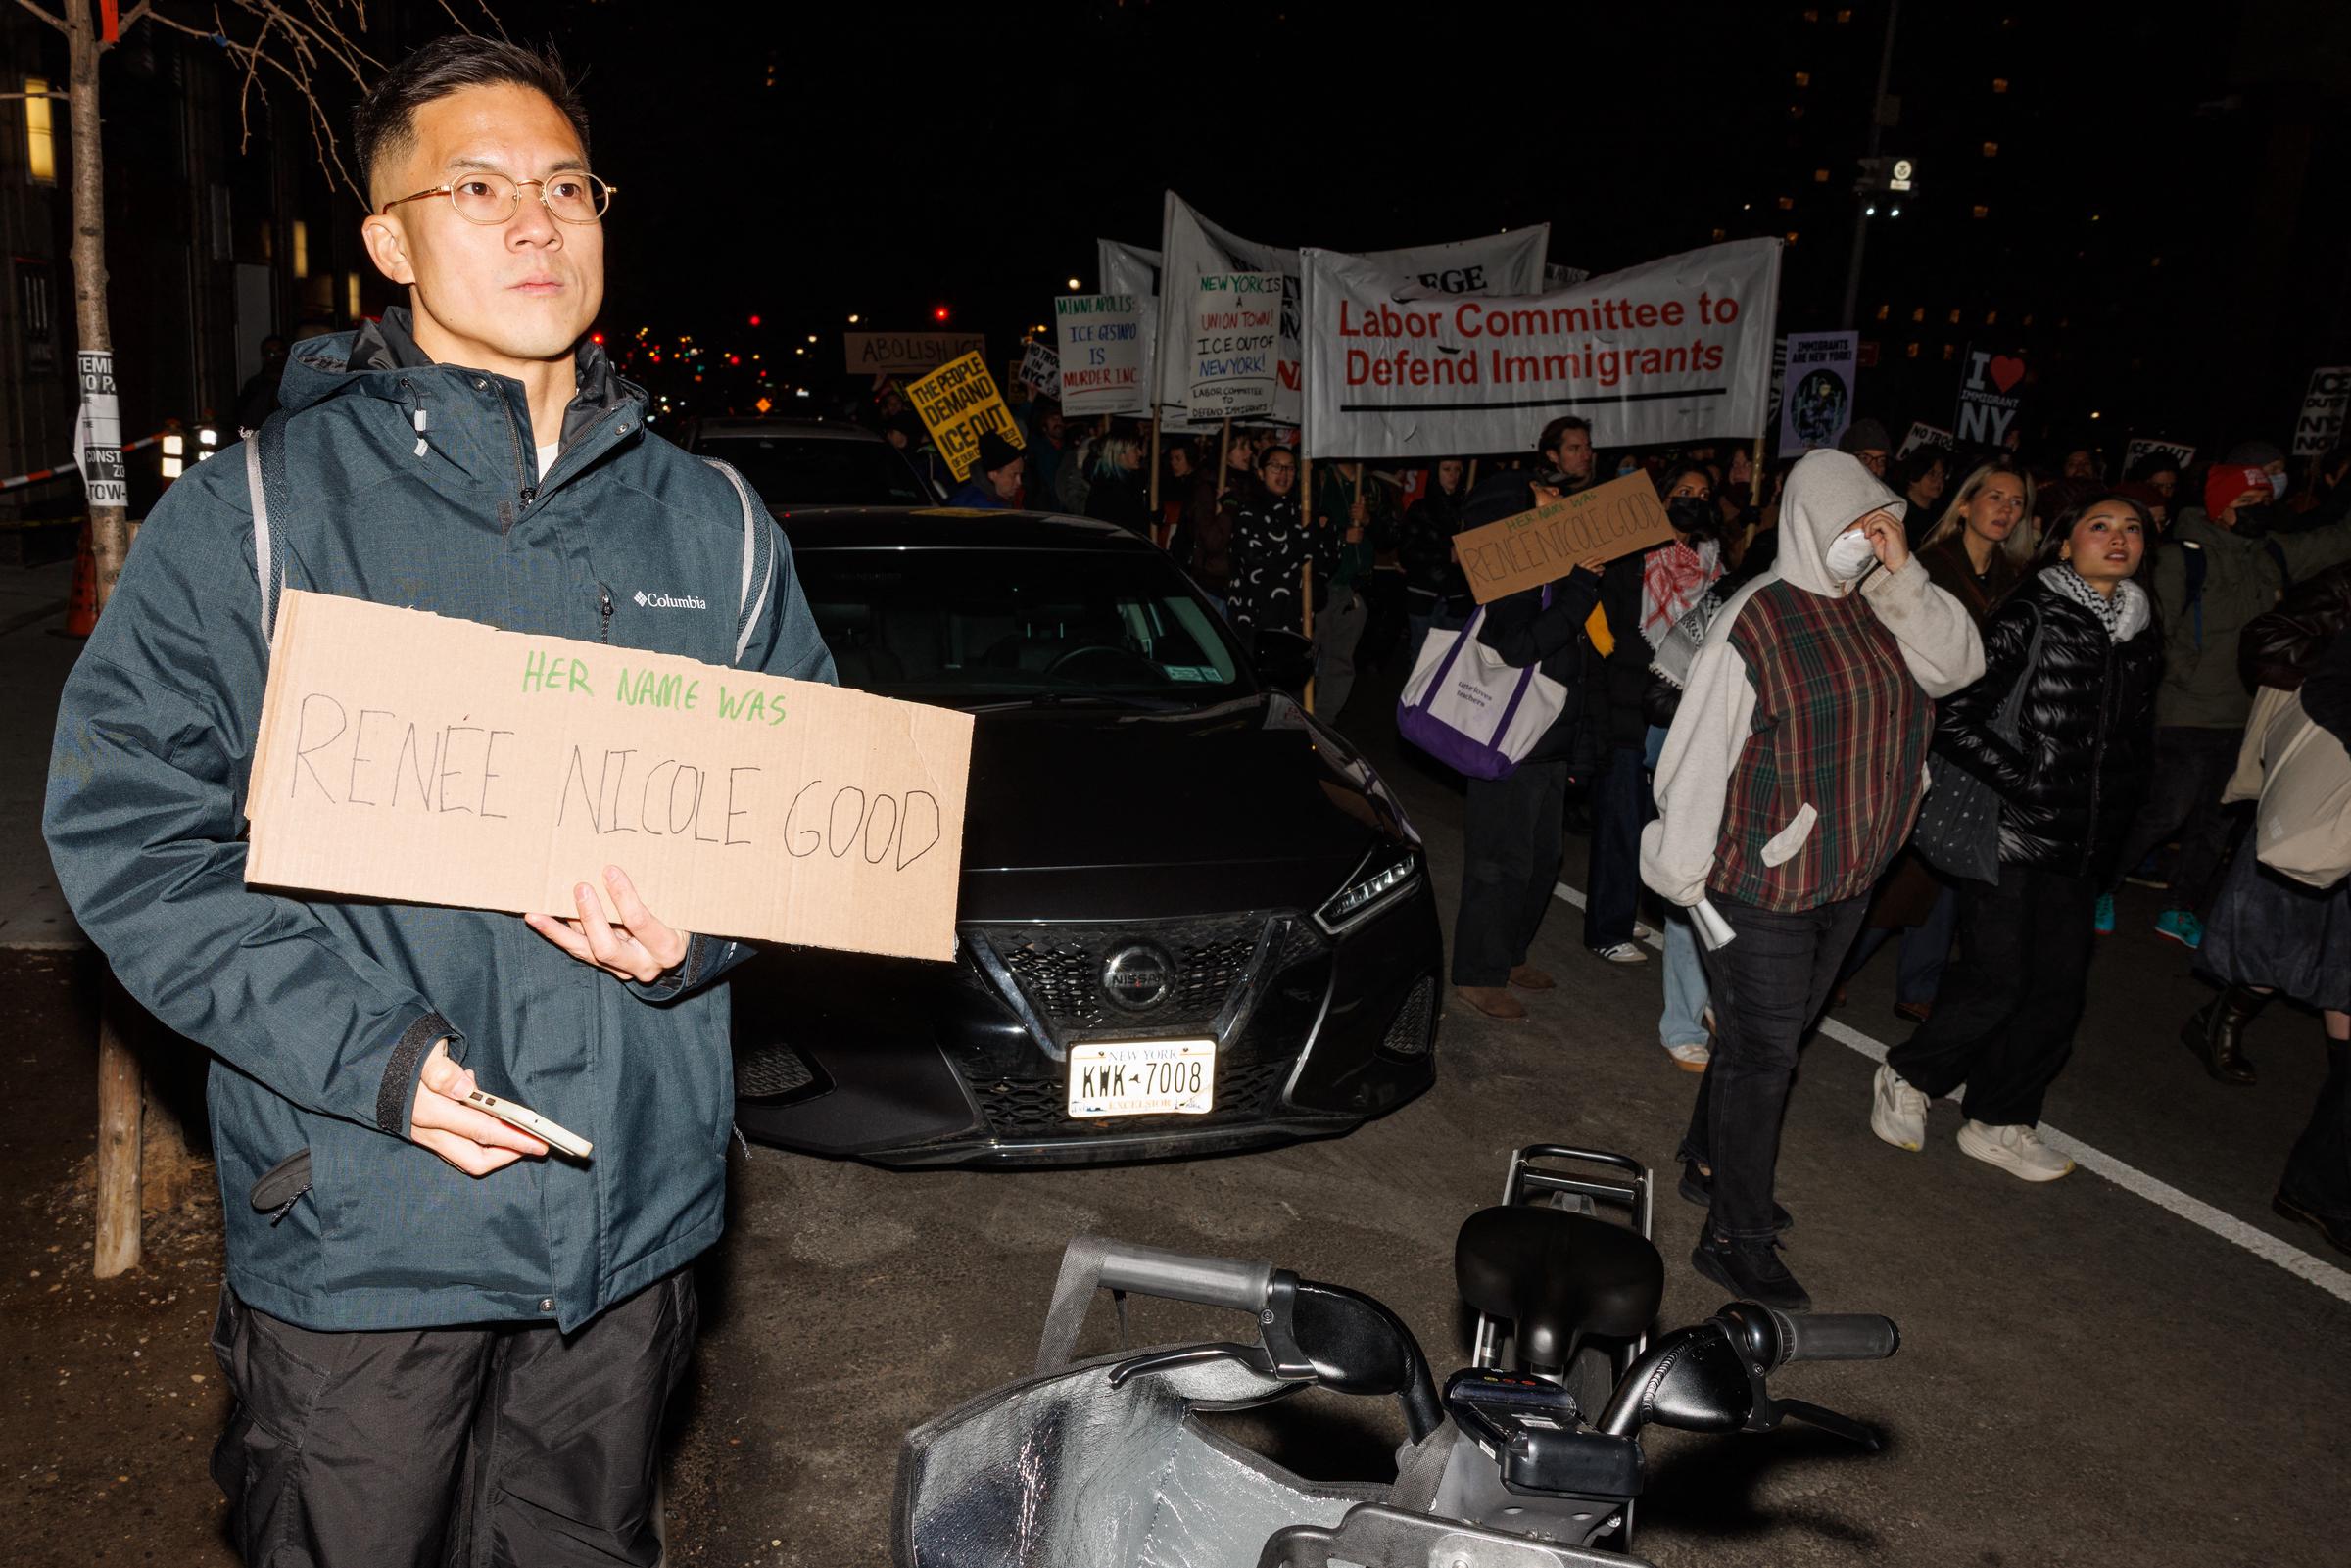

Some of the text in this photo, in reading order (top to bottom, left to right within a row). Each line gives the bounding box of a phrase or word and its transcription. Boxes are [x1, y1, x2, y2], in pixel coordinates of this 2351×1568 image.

[1201, 276, 1228, 292] NEW
[1229, 275, 1265, 294] YORK
[1265, 277, 1282, 293] IS
[1236, 296, 1243, 308] A
[1201, 312, 1239, 331] UNION
[1240, 309, 1273, 329] TOWN!
[1339, 300, 1443, 338] Labor
[1455, 297, 1685, 338] Committee
[1698, 291, 1740, 325] to
[1070, 323, 1137, 343] ICE GESTAPO
[863, 337, 948, 362] ABOLISH
[1197, 335, 1275, 356] ICE OUT OF
[1798, 339, 1848, 352] IMMIGRANTS
[1032, 358, 1044, 371] IN
[1089, 348, 1106, 365] IS
[1199, 354, 1266, 377] NEW YORK!
[1347, 349, 1479, 386] Defend
[1493, 338, 1725, 387] Immigrants
[912, 380, 941, 405] THE
[936, 356, 984, 392] PEOPLE
[1021, 365, 1045, 388] NYC
[1064, 368, 1112, 388] MURDER
[1966, 351, 1991, 391] I
[924, 375, 994, 427] DEMAND
[1192, 388, 1223, 399] LABOR
[1223, 395, 1234, 404] TO
[1192, 407, 1223, 418] DEFEND
[938, 402, 1007, 457] ICE OUT
[1912, 425, 1928, 439] NO
[1958, 401, 2018, 447] NY
[86, 450, 123, 463] CONST
[1505, 513, 1535, 533] HER
[1535, 507, 1612, 563] NICOLE
[1607, 492, 1663, 538] GOOD
[648, 593, 706, 609] Columbia
[522, 649, 788, 726] HER NAME WAS
[292, 693, 940, 872] RENÉE NICOLE GOOD
[1112, 972, 1167, 987] NISSAN
[1109, 1049, 1177, 1062] NEW YORK
[1109, 1098, 1172, 1110] EXCELSIOR
